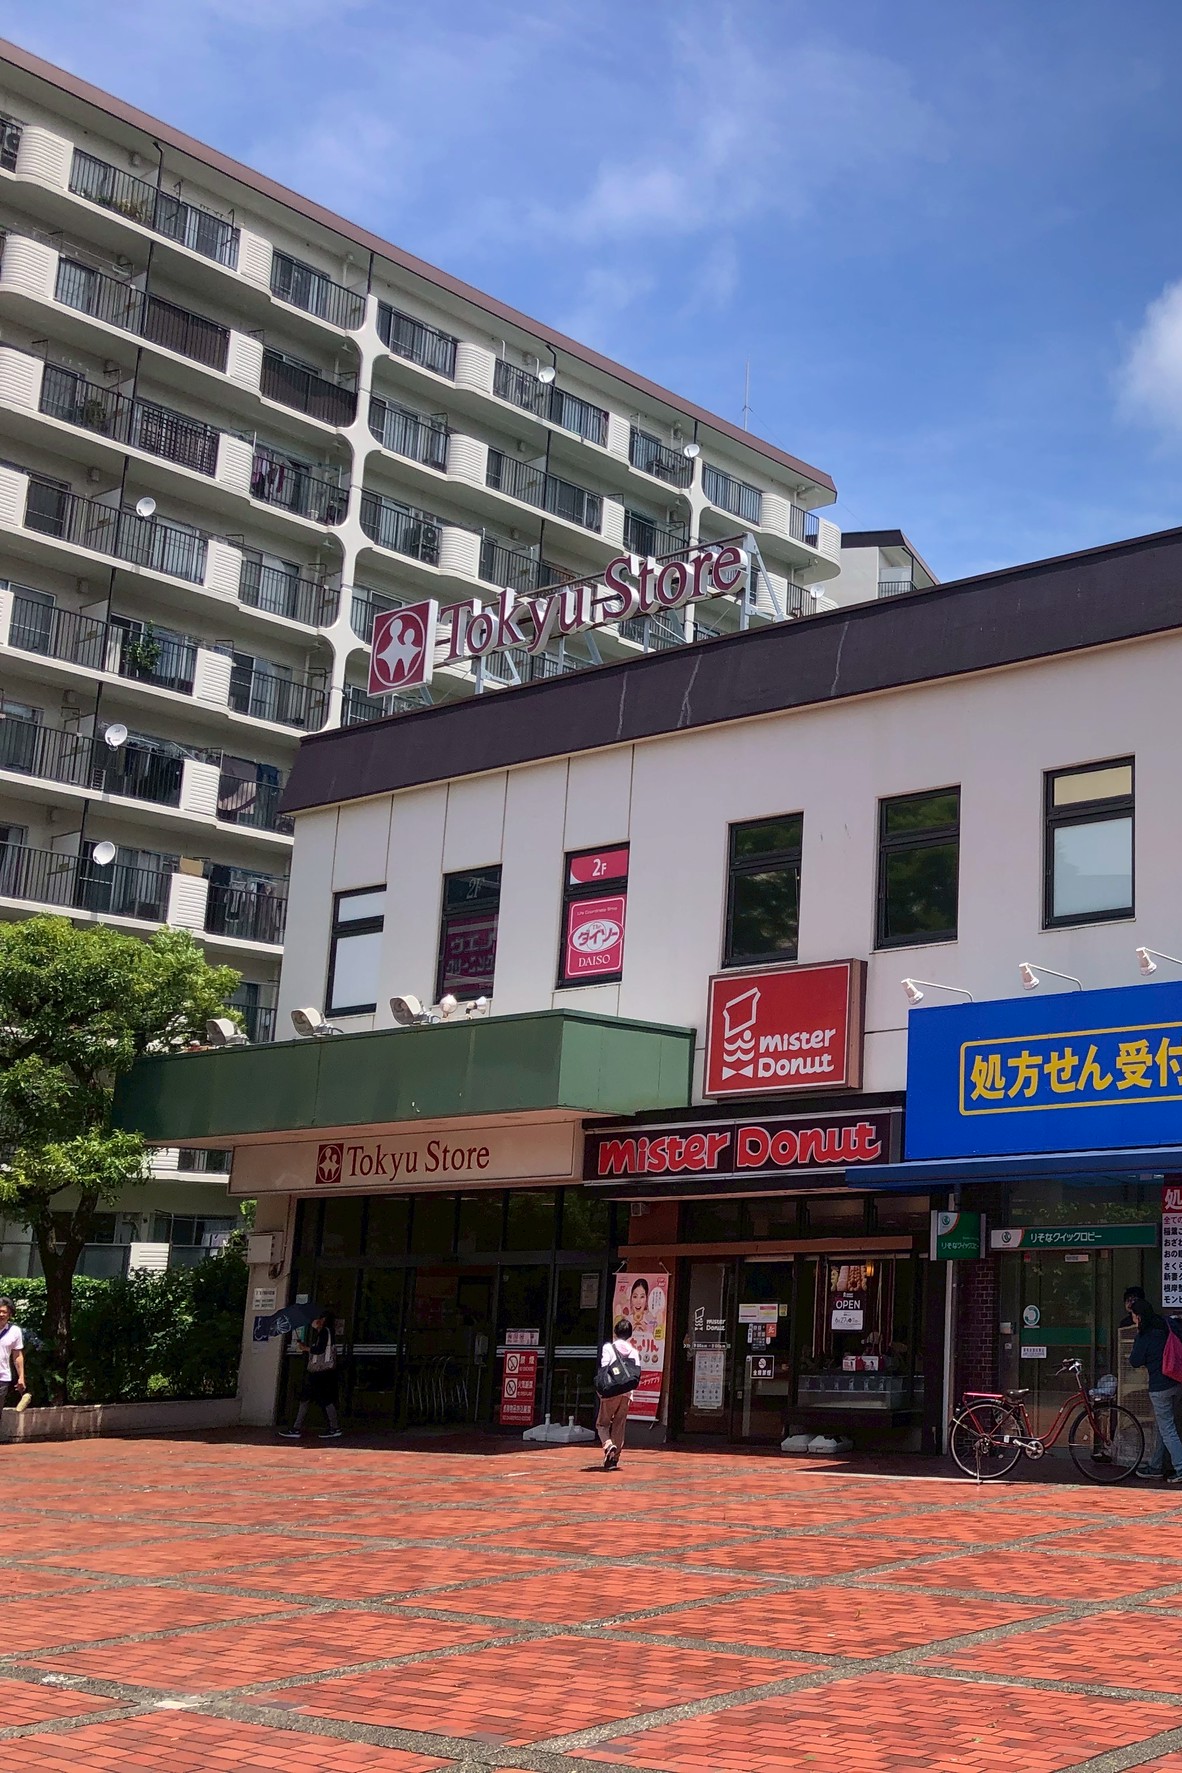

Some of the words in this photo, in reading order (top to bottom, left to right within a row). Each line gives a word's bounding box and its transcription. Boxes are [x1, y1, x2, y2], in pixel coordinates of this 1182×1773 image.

[440, 587, 594, 662] Tokyu
[600, 545, 749, 624] Store
[592, 858, 607, 877] 2F
[578, 927, 618, 946] ダイソー
[579, 954, 611, 968] DAISO
[757, 1053, 835, 1078] Donut
[736, 1121, 882, 1168] Donut
[347, 1144, 418, 1182] Tokyu
[425, 1140, 490, 1173] Store
[1030, 1231, 1102, 1243] りそなクイックロビー
[835, 1299, 861, 1310] OPEN
